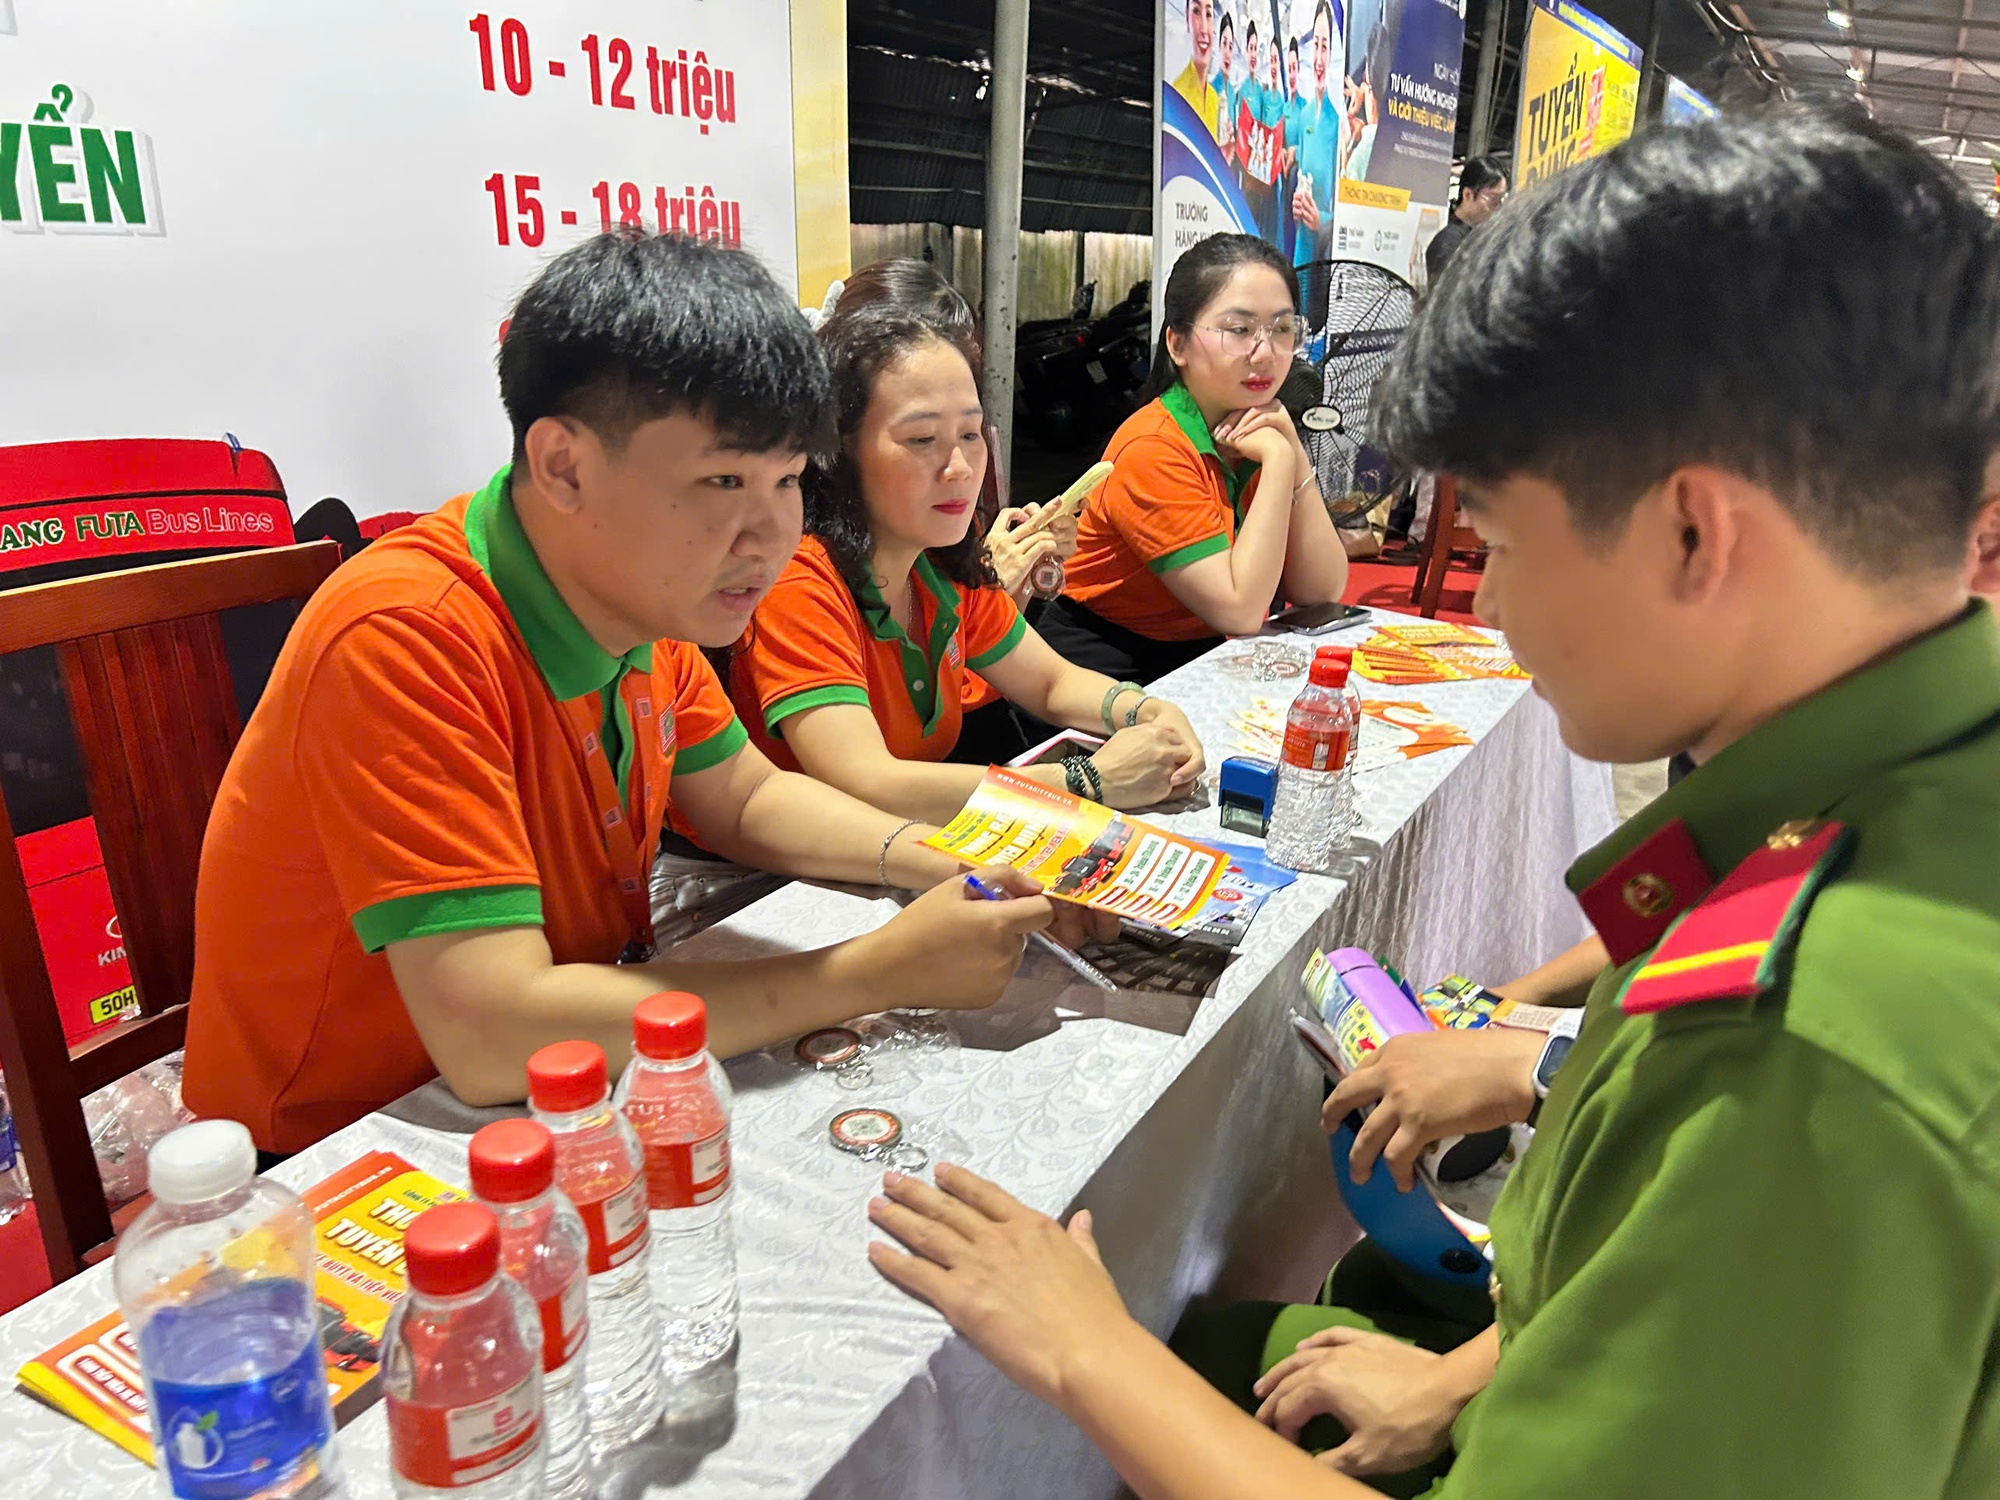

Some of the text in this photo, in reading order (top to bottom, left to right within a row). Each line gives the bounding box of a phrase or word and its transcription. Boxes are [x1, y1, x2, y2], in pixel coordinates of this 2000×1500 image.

[468, 13, 737, 136] 10 - 12 triệu
[1527, 52, 1587, 164] TUYỂN
[484, 172, 545, 248] 15
[560, 210, 577, 225] -
[592, 180, 644, 242] 18
[0, 506, 275, 551] ANG FUTA Bus Lines
[101, 990, 135, 1016] 50H
